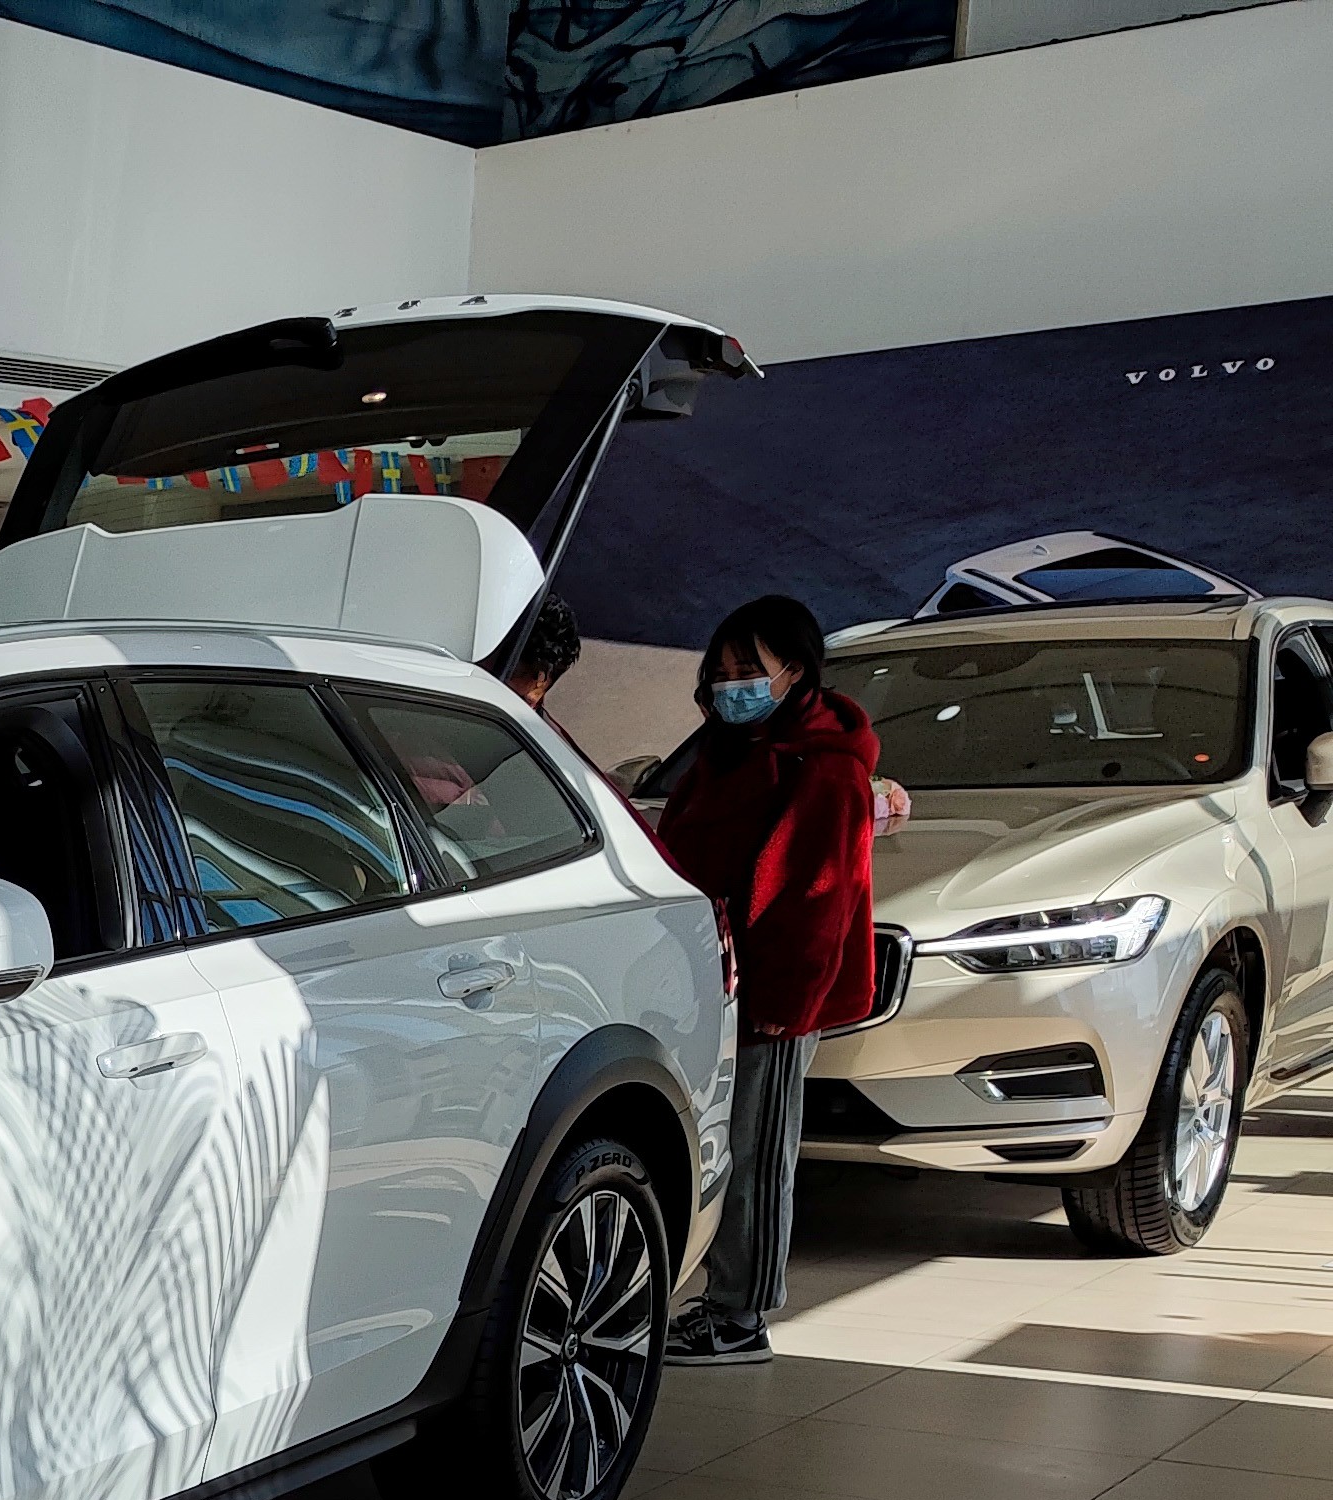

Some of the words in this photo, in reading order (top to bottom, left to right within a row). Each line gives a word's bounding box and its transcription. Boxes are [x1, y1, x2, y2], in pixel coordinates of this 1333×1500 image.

[1125, 357, 1276, 385] VOLVO
[576, 1165, 586, 1186] P
[589, 1152, 632, 1173] ZERO
